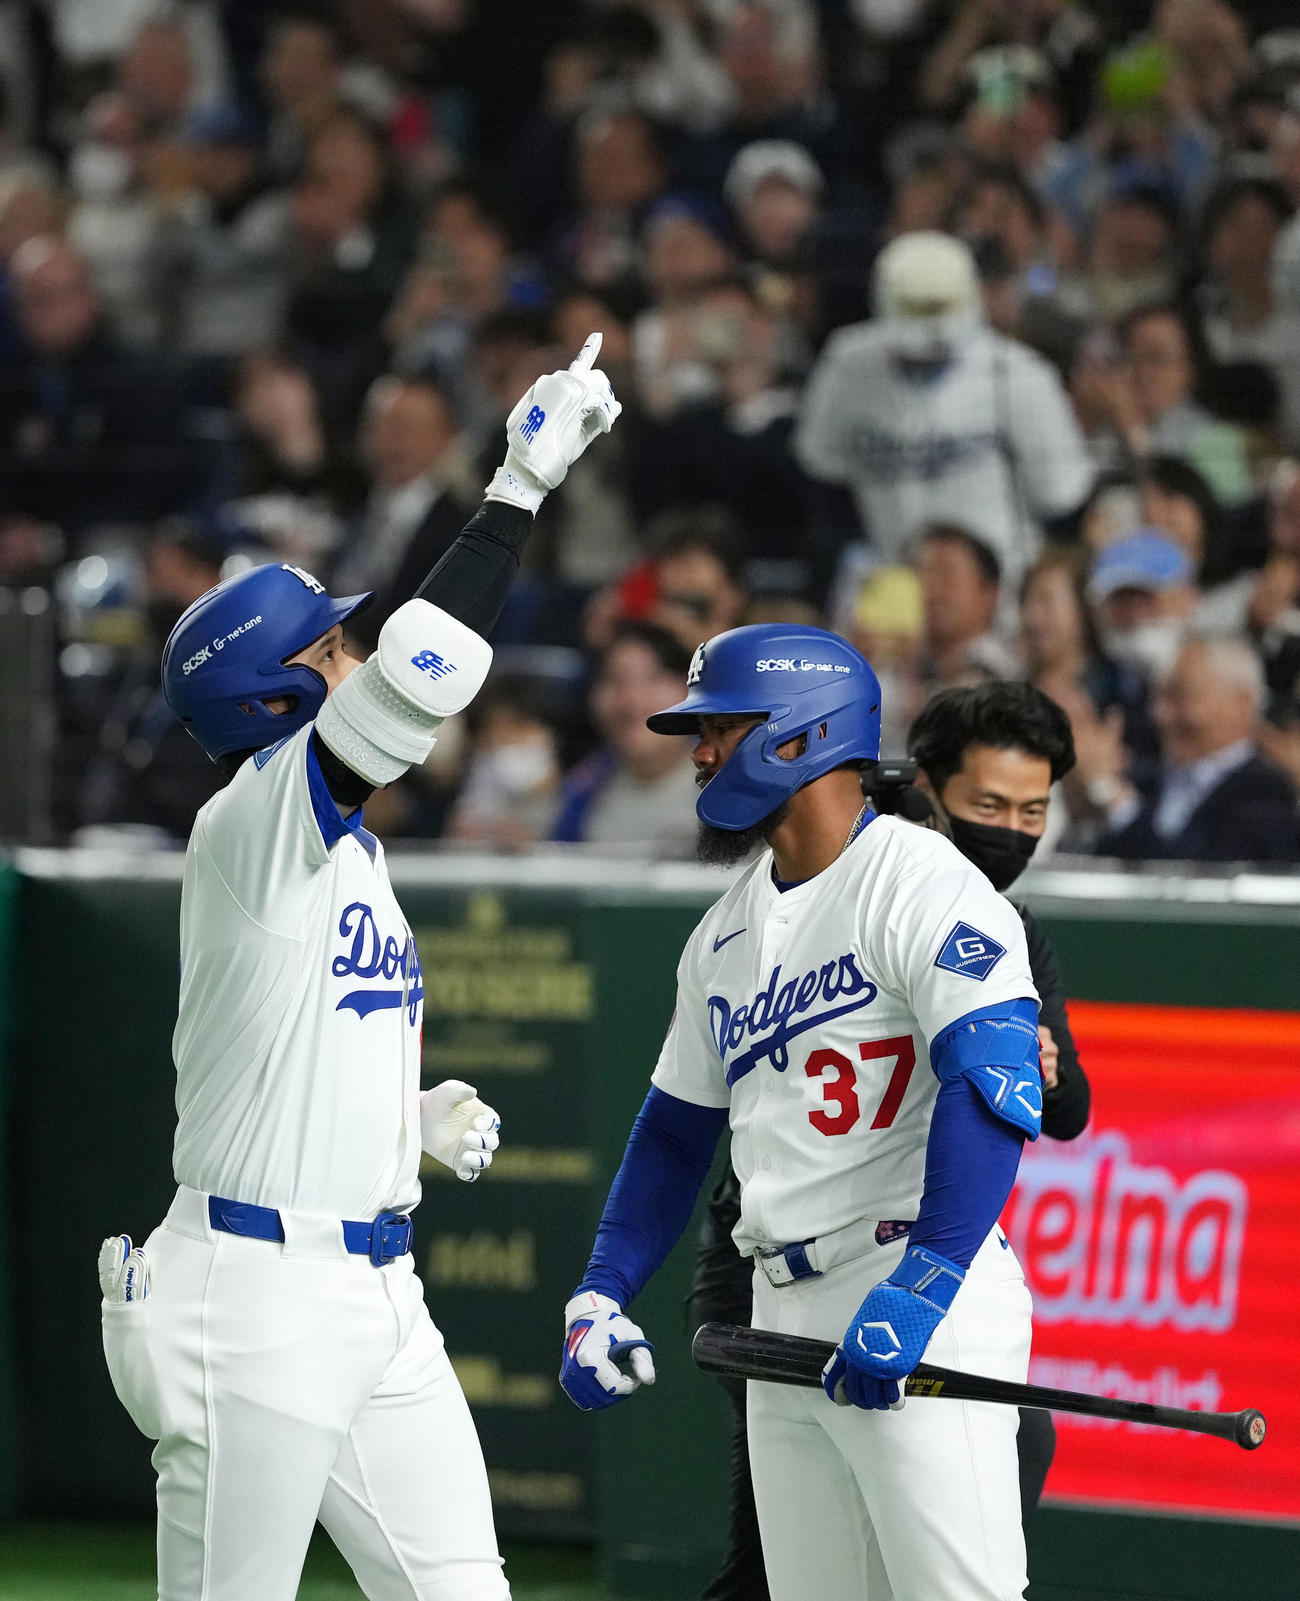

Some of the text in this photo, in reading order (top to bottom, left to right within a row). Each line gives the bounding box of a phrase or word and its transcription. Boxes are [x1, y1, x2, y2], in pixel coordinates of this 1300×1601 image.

[182, 645, 214, 676] SCSK
[756, 658, 798, 672] SCSK
[955, 936, 986, 959] G
[707, 952, 878, 1073] Dodgers
[804, 1034, 917, 1137] 37
[1000, 1142, 1240, 1320] elna
